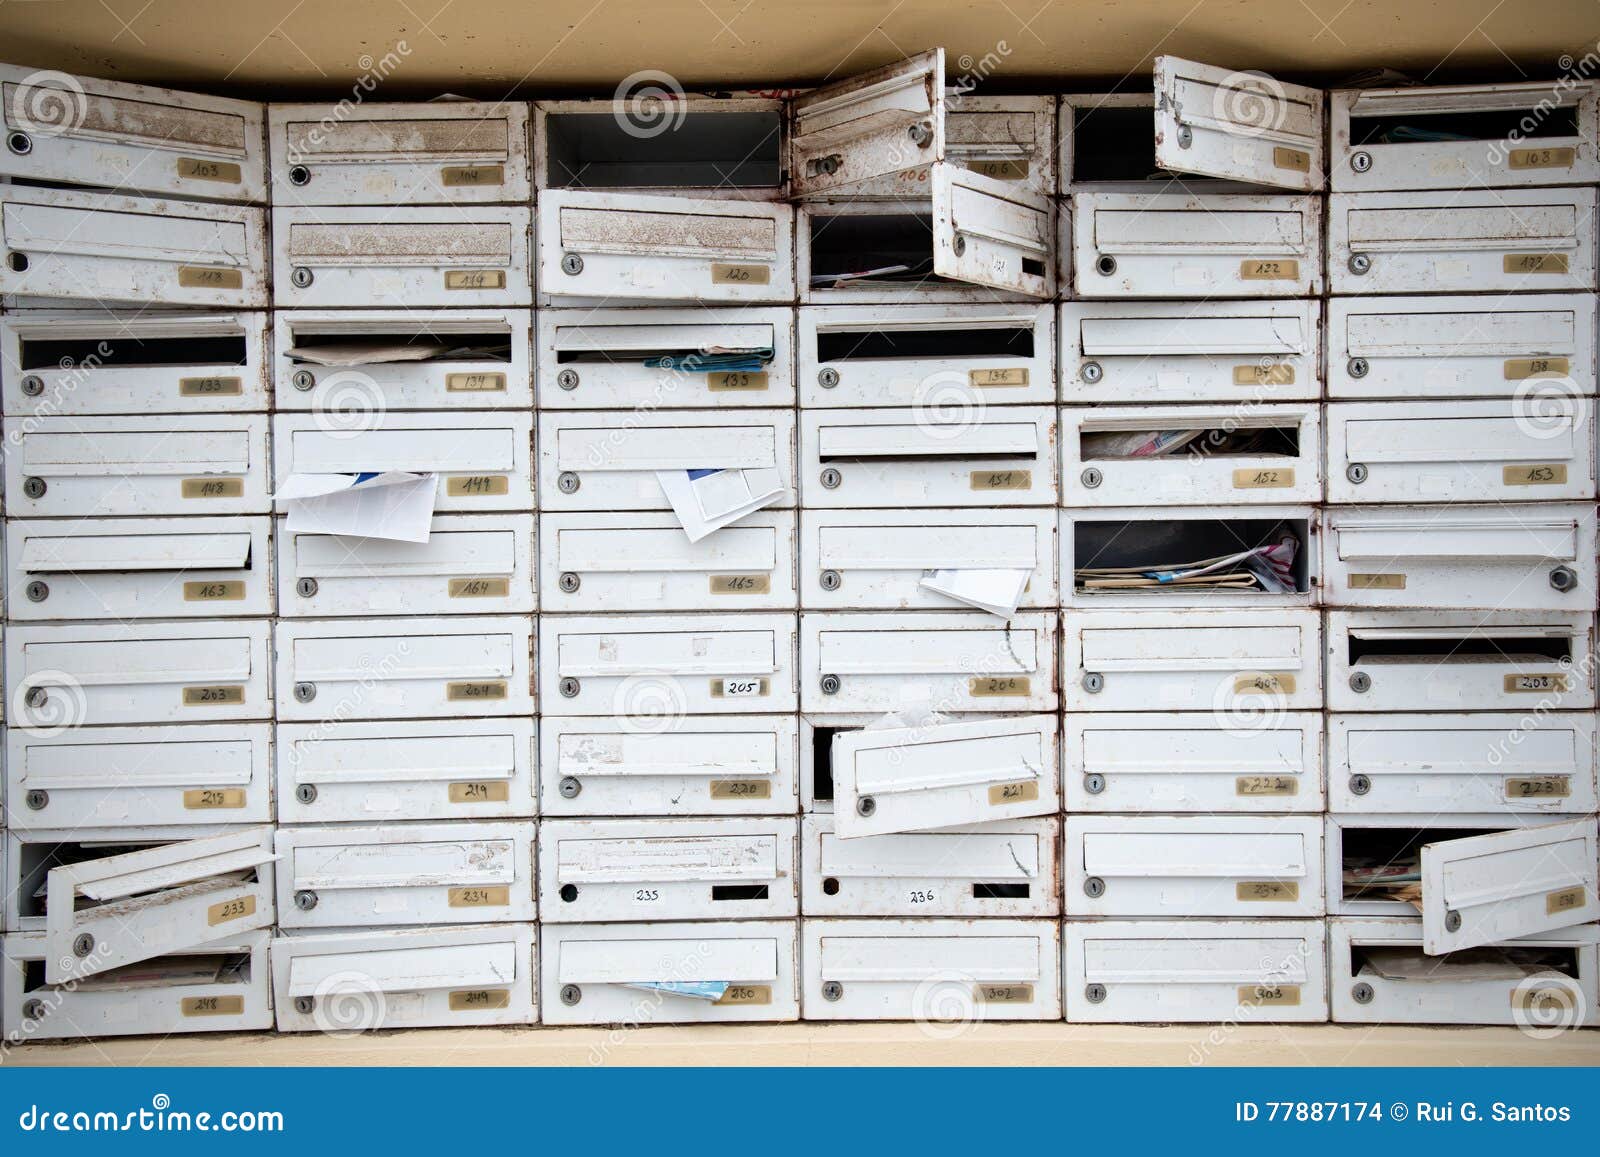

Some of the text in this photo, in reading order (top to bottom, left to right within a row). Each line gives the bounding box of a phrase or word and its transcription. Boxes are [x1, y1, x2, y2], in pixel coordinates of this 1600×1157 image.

[191, 164, 219, 177] 103
[899, 169, 927, 182] 106
[725, 269, 750, 280] 120
[1255, 263, 1281, 274] 122
[1530, 361, 1549, 373] 138
[724, 373, 751, 387] 135
[988, 370, 1008, 382] 136
[199, 381, 222, 392] 133
[464, 376, 485, 390] 134
[988, 474, 1013, 487] 151
[1253, 472, 1279, 484] 152
[1526, 468, 1554, 481] 153
[201, 482, 225, 497] 148
[463, 582, 488, 594] 164
[728, 578, 754, 590] 165
[200, 585, 226, 597] 163
[728, 682, 757, 694] 205
[989, 679, 1016, 691] 206
[201, 688, 226, 701] 203
[465, 784, 488, 799] 219
[464, 891, 488, 903] 234
[636, 889, 658, 901] 235
[910, 890, 935, 903] 236
[221, 902, 245, 917] 233
[194, 999, 218, 1010] 248
